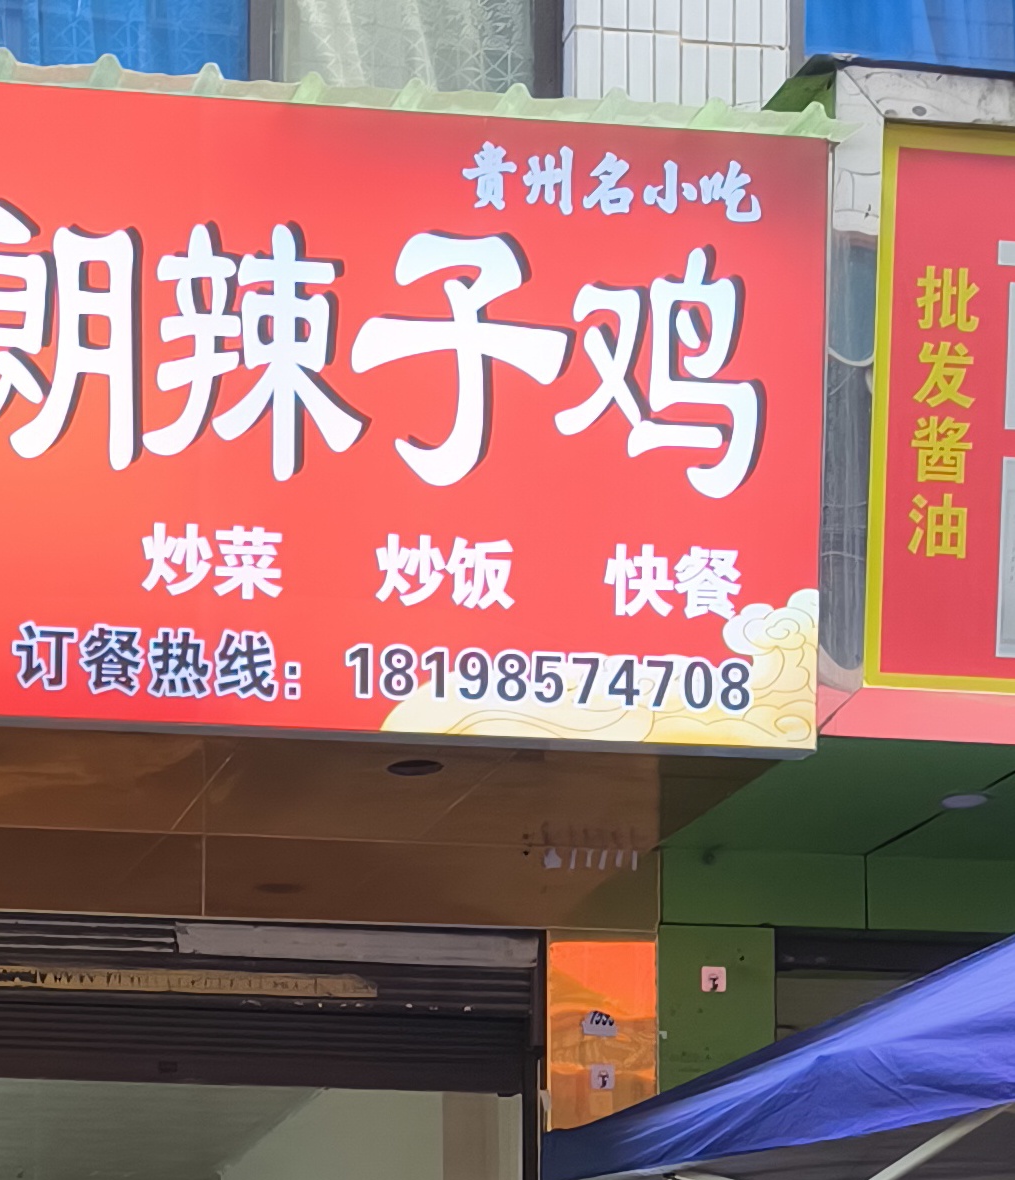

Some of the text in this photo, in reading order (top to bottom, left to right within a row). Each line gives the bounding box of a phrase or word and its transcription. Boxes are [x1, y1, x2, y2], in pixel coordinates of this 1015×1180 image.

[461, 141, 762, 223] 贵州名小吃
[907, 265, 980, 559] 批发酱油
[141, 522, 742, 620] 炒菜 炒饭 快餐
[345, 643, 753, 713] 18198574708
